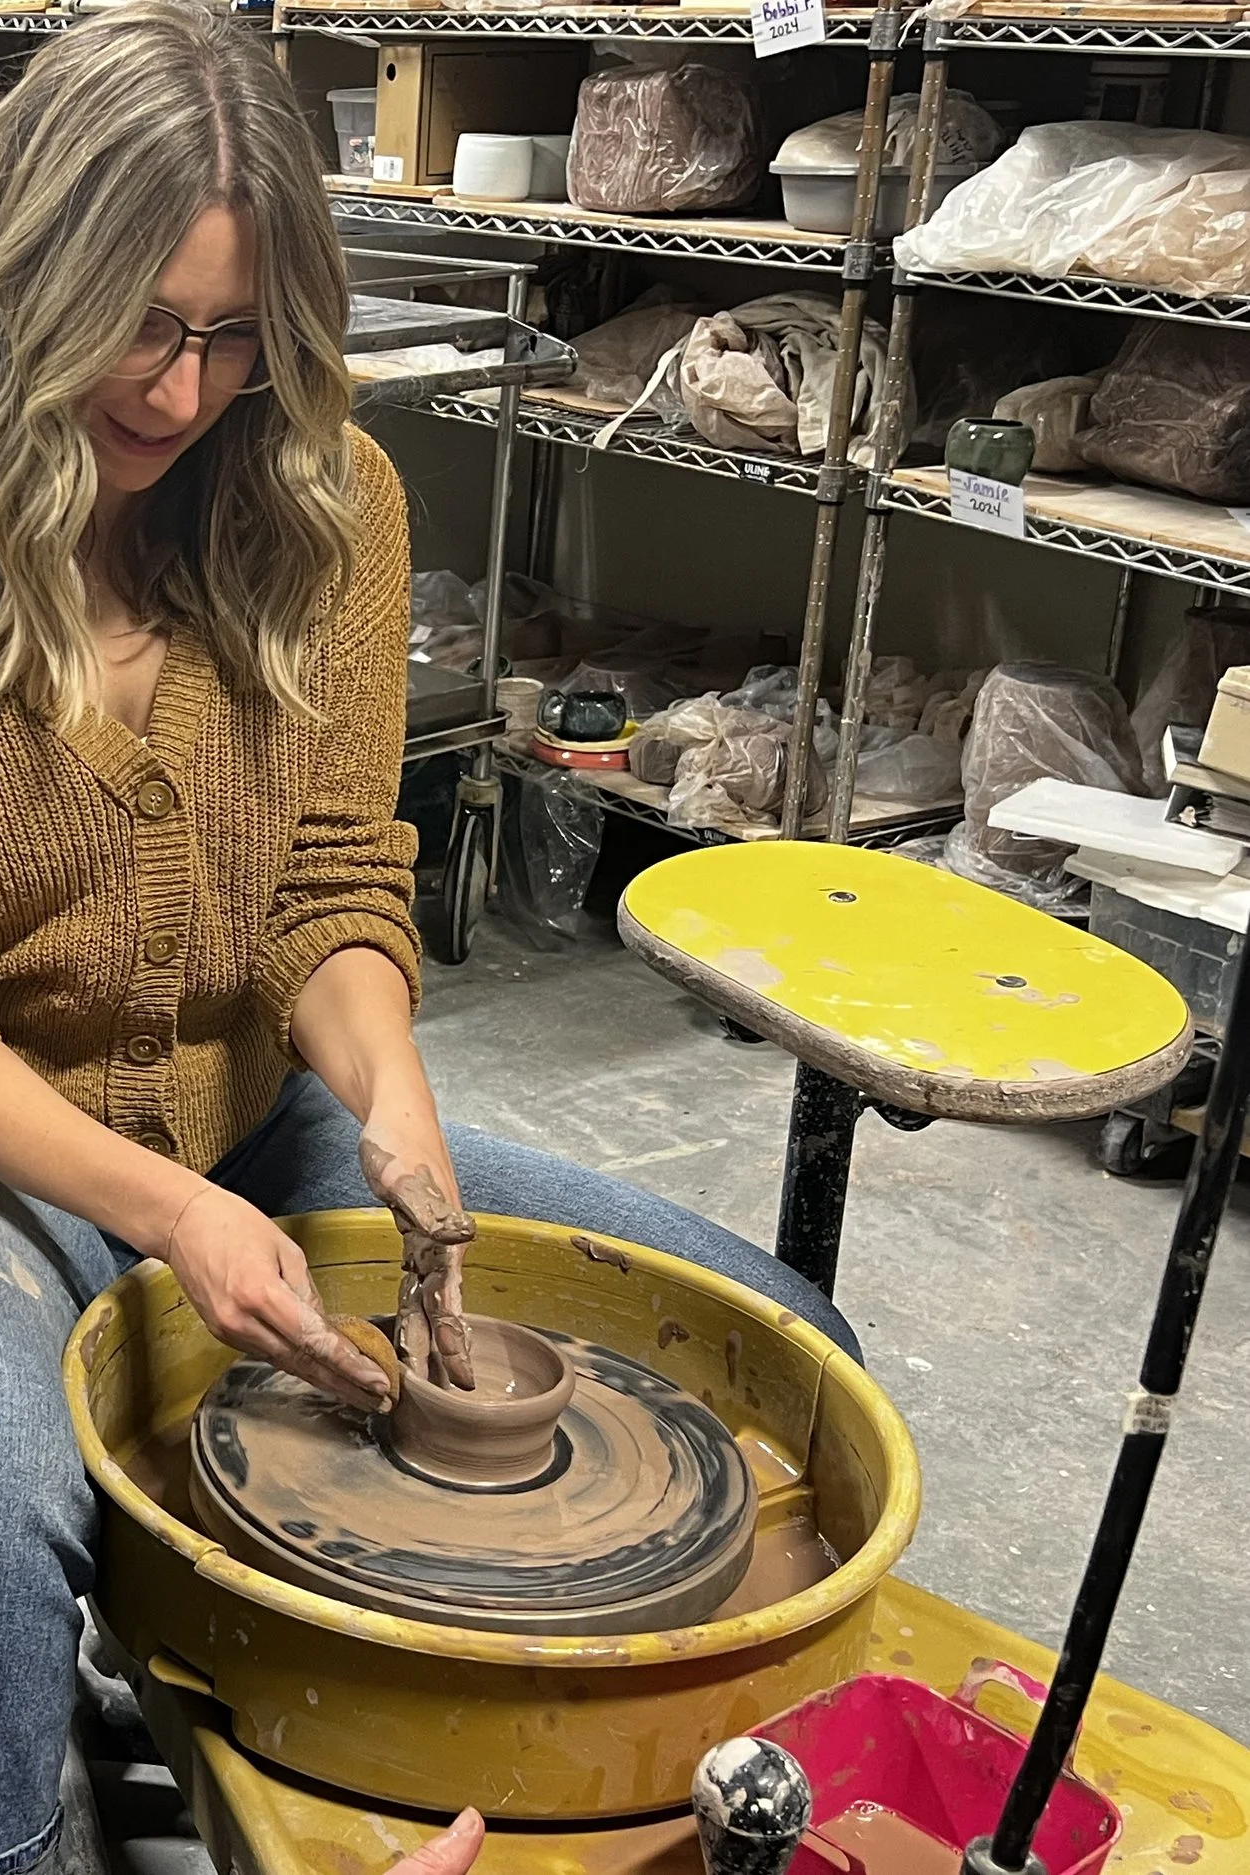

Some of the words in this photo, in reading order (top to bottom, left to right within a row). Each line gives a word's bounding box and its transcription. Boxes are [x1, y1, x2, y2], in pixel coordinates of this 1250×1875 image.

[762, 0, 799, 22] Bobbi
[769, 17, 799, 39] 2024
[744, 462, 771, 477] ULINE
[963, 476, 1010, 504] Jamie
[970, 498, 1002, 518] 2024
